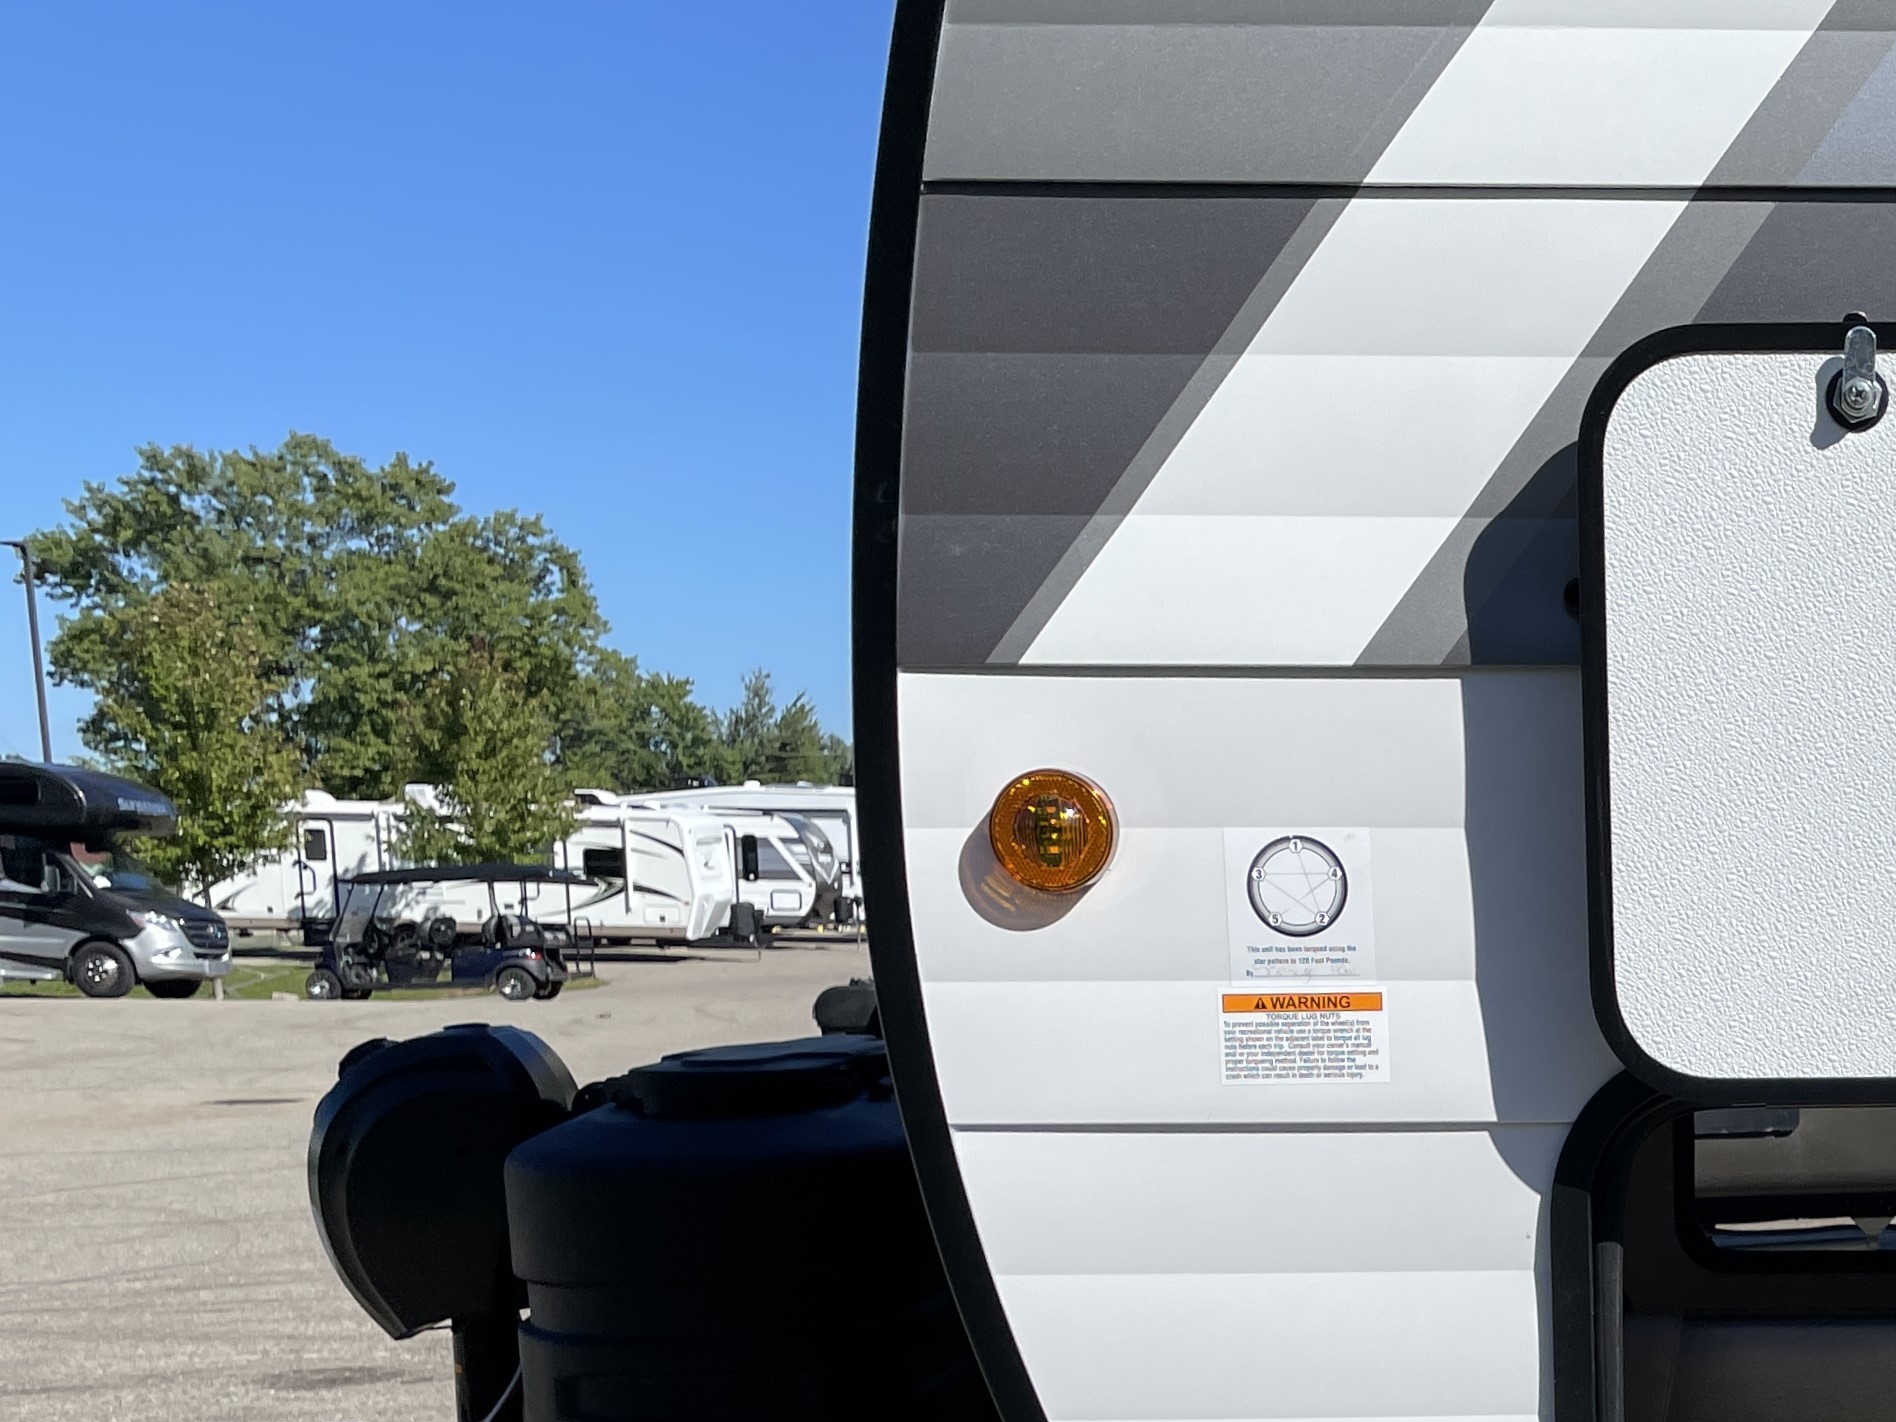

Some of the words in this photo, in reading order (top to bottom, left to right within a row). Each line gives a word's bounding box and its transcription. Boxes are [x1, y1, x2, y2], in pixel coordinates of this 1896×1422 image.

[1293, 841, 1298, 851] 1
[1256, 869, 1262, 880] 3
[1331, 869, 1338, 880] 4
[1272, 914, 1279, 925] 5
[1319, 914, 1326, 925] 2
[1270, 995, 1351, 1010] WARNING
[1266, 1013, 1298, 1021] TORQUE
[1301, 1012, 1317, 1020] LUG
